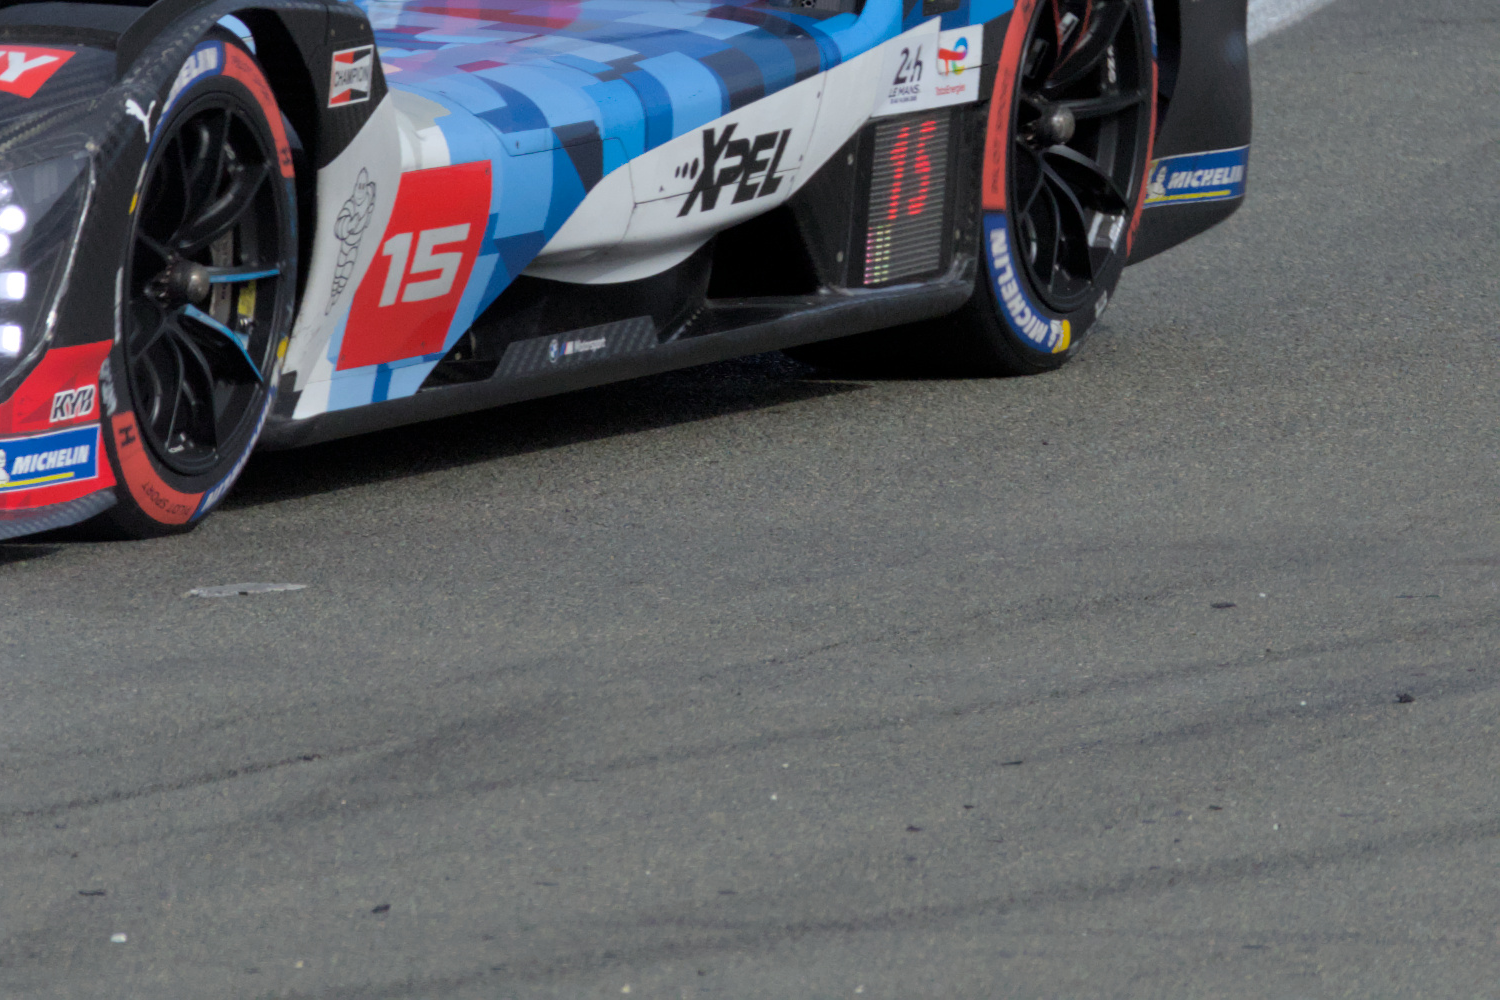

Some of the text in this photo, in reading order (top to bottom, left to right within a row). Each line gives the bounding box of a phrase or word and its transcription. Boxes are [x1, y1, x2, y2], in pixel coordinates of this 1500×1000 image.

[334, 66, 370, 88] CHAMPION
[676, 122, 793, 218] XPEL
[1167, 164, 1245, 190] MICHELIN
[379, 222, 471, 309] 15
[989, 227, 1049, 344] MICHELIN
[51, 385, 96, 421] KYB
[11, 444, 90, 476] MICHELIN
